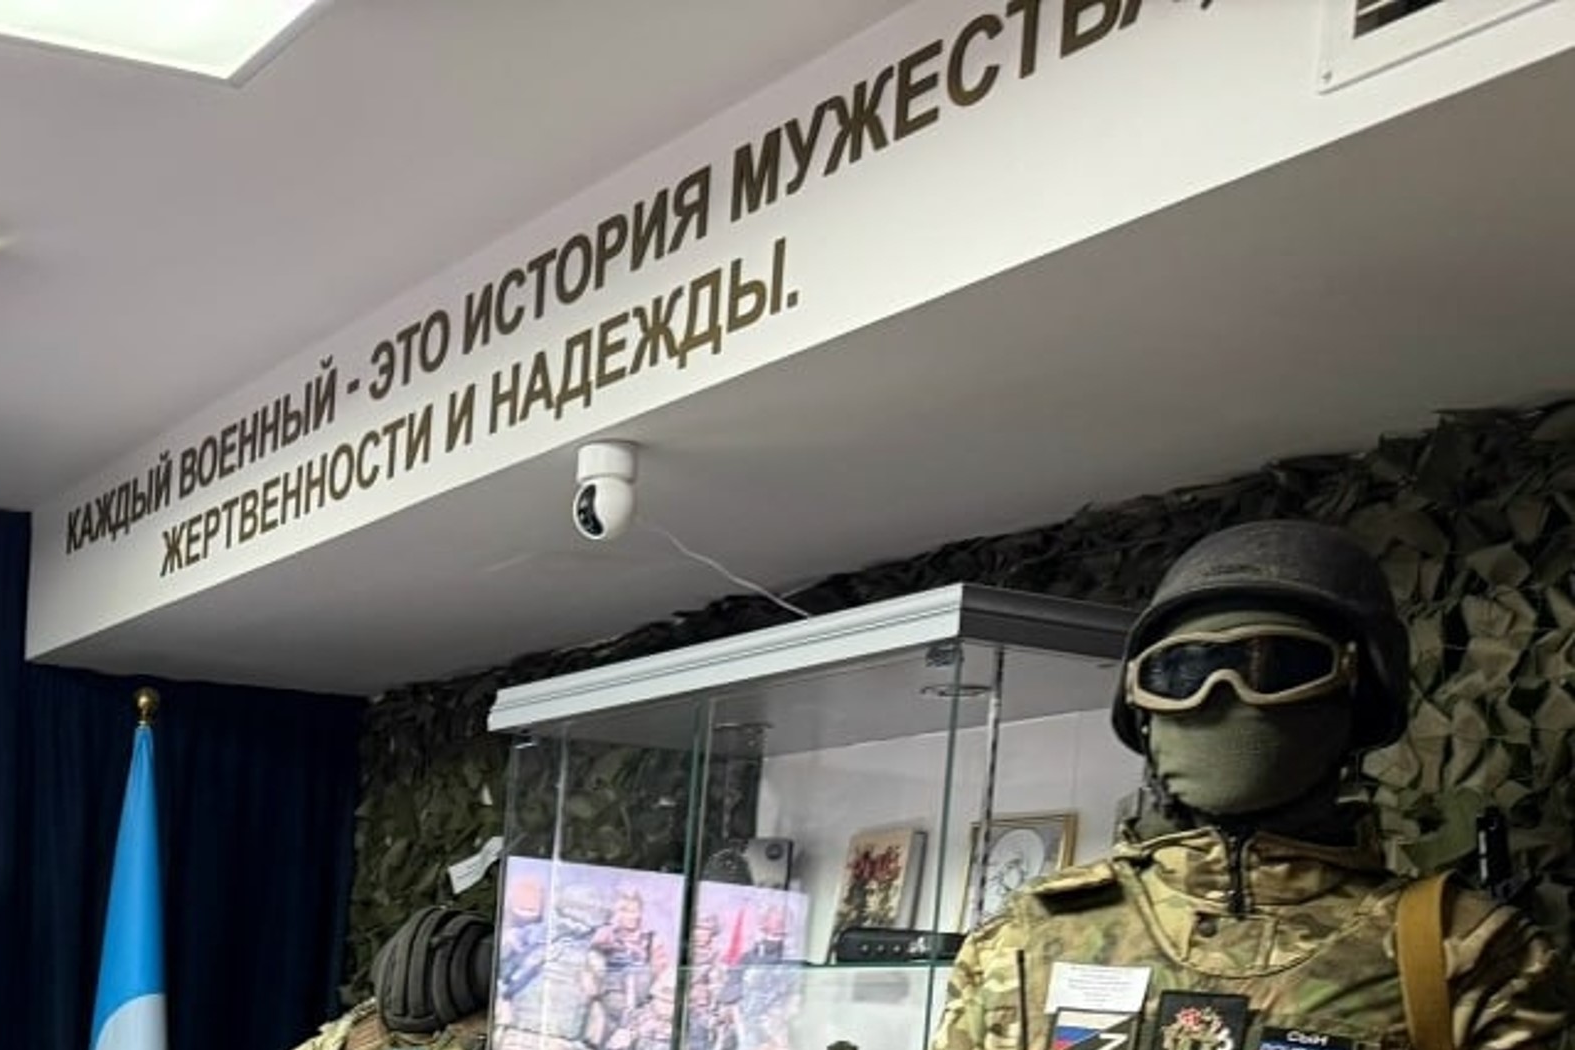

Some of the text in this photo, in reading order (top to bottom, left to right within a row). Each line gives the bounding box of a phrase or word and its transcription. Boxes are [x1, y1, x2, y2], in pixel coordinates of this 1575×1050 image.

[65, 0, 1215, 557] КАЖДЫЙ ВОЕННЫЙ - ЭТО ИСТОРИЯ МУЖЕСТВ
[160, 237, 800, 577] ЖЕРТВЕННОСТИ И НАДЕЖДЫ.
